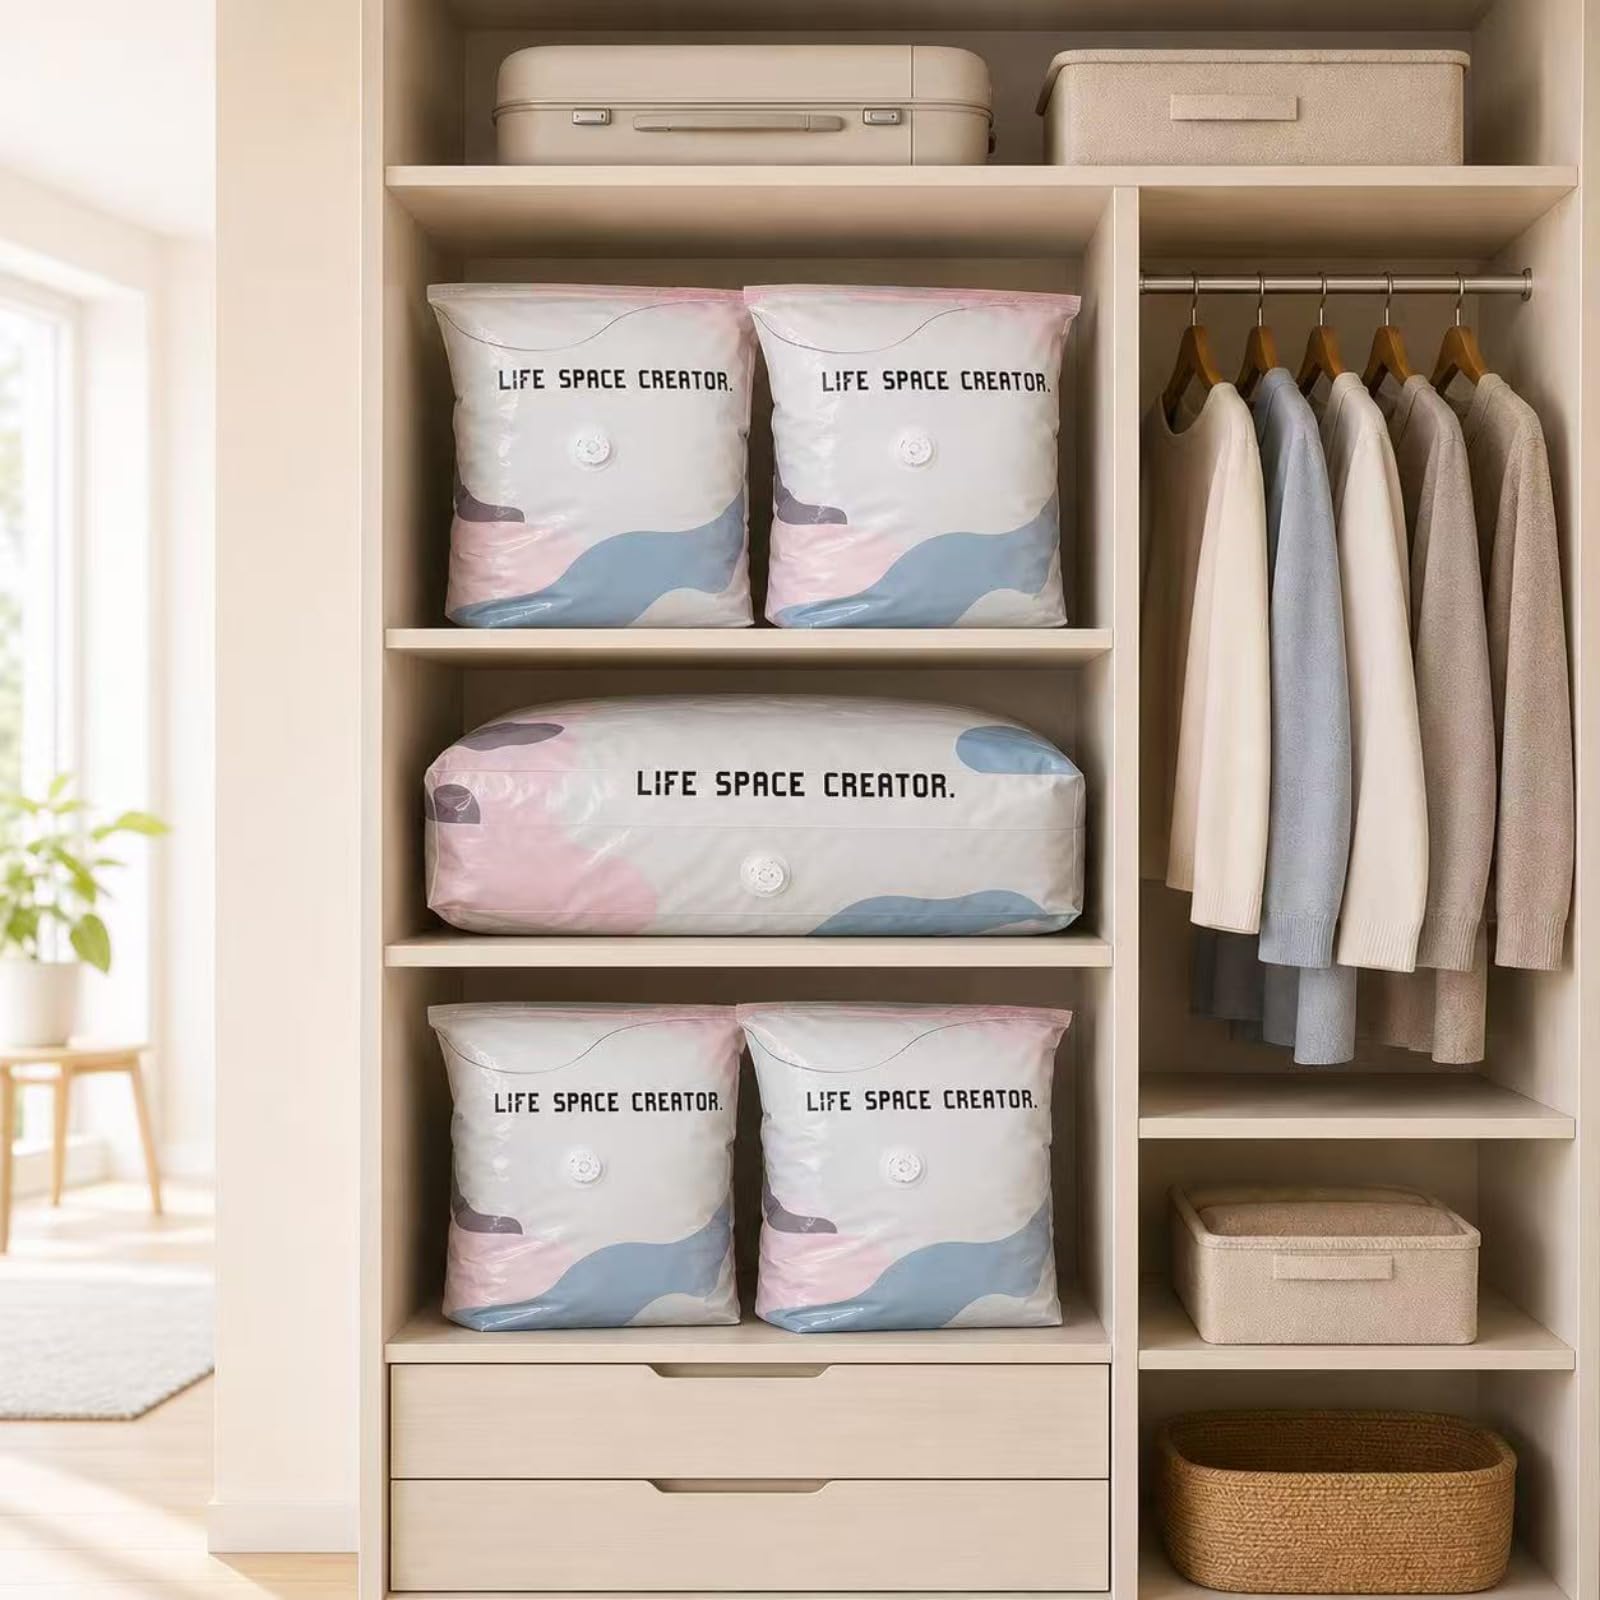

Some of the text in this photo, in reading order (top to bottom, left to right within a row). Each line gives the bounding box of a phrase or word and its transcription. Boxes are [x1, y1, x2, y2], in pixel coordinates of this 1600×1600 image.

[498, 369, 733, 392] LIFE SPACE CREATOR.
[822, 370, 1051, 393] LIFE SPACE CREATOR.
[637, 770, 955, 799] LIFE SPACE CREATOR.
[494, 1091, 723, 1113] LIFE SPACE CREATOR.
[807, 1089, 1038, 1112] LIFE SPACE CREATOR.
